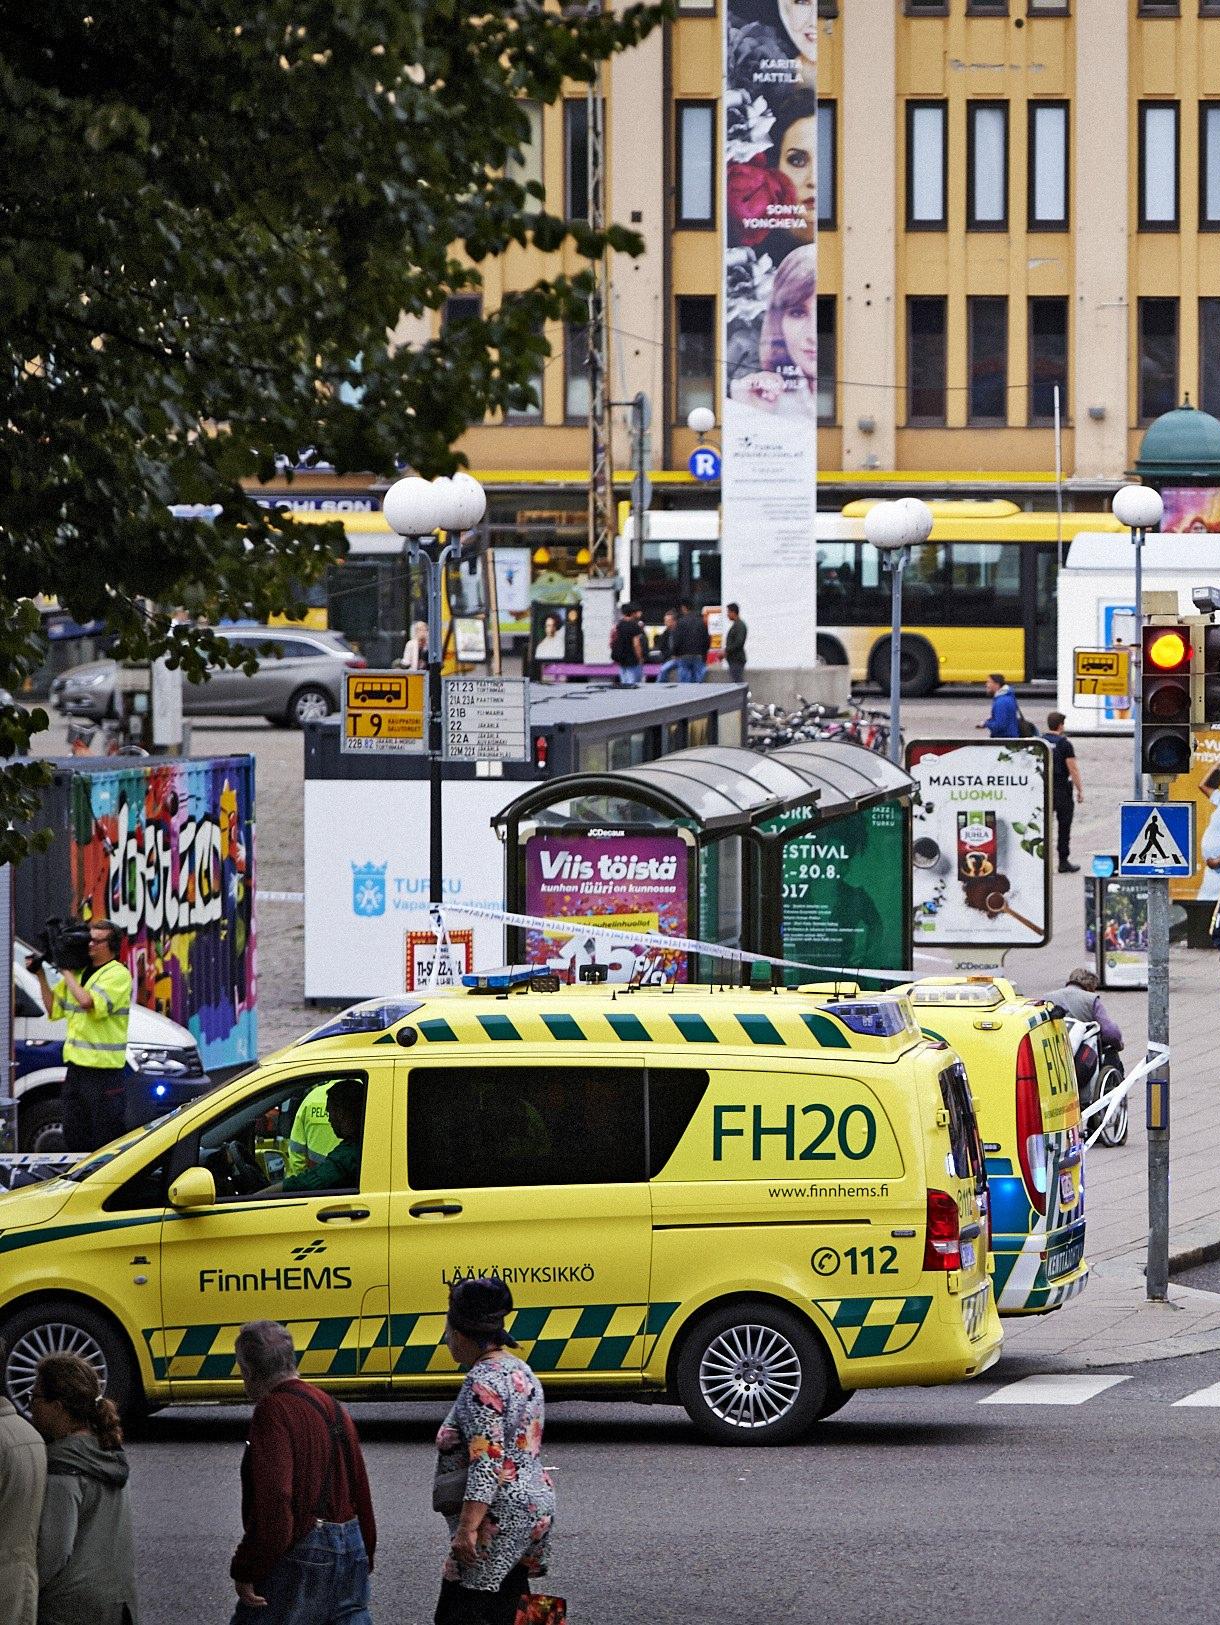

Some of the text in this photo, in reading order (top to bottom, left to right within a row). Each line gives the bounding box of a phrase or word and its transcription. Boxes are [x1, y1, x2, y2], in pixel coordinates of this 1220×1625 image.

[760, 58, 803, 69] KARITA
[753, 72, 804, 83] MATTILA
[766, 204, 807, 215] SONYA
[742, 218, 807, 229] YONCHEVA
[695, 453, 716, 477] R
[347, 713, 383, 737] T 9
[449, 721, 462, 732] 22
[449, 734, 469, 745] 22A
[928, 775, 1029, 787] MAISTA REILU
[950, 789, 1008, 801] LUOMU.
[587, 828, 625, 838] JCDecaux
[783, 844, 849, 859] ESTIVAL
[539, 850, 678, 881] Viis töistä
[540, 881, 676, 895] kunhan lüüri on kunnossa
[712, 1103, 877, 1161] FH20
[768, 1184, 889, 1198] www.finnhems.fi
[843, 1245, 899, 1276] 112
[199, 1266, 353, 1293] FinnHEMS
[441, 1262, 595, 1286] LÄÄKÄRIYKSIKKÖ
